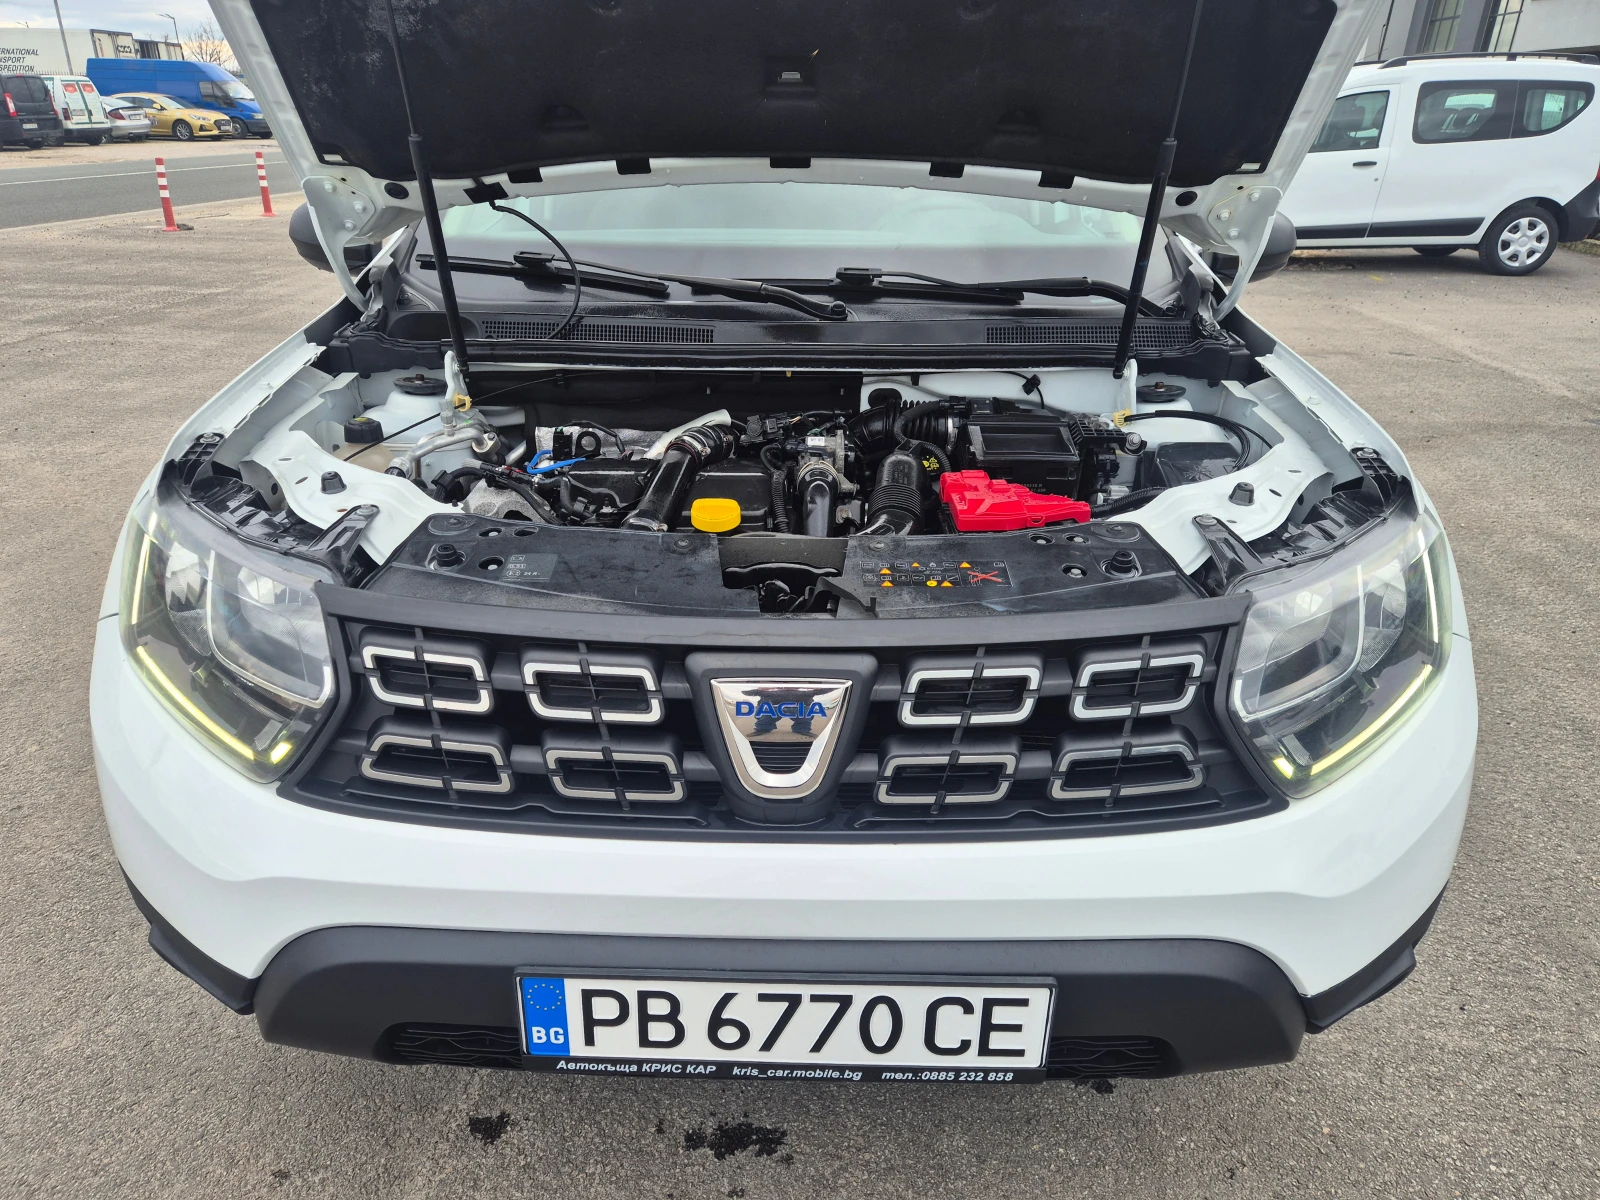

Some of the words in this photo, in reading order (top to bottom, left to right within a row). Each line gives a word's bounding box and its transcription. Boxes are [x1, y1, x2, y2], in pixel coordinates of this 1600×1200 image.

[0, 47, 39, 56] RNATIONAL
[735, 701, 827, 718] DACIA
[580, 988, 686, 1049] PB
[707, 992, 904, 1055] 6770
[923, 996, 1030, 1058] CE
[531, 1026, 565, 1044] BG
[556, 1060, 638, 1073] Автокъща
[641, 1063, 683, 1074] КРИС
[685, 1064, 717, 1074] КАР
[732, 1066, 863, 1081] kris_car.mobile.bg
[958, 1071, 985, 1081] 232
[987, 1072, 1014, 1082] 858
